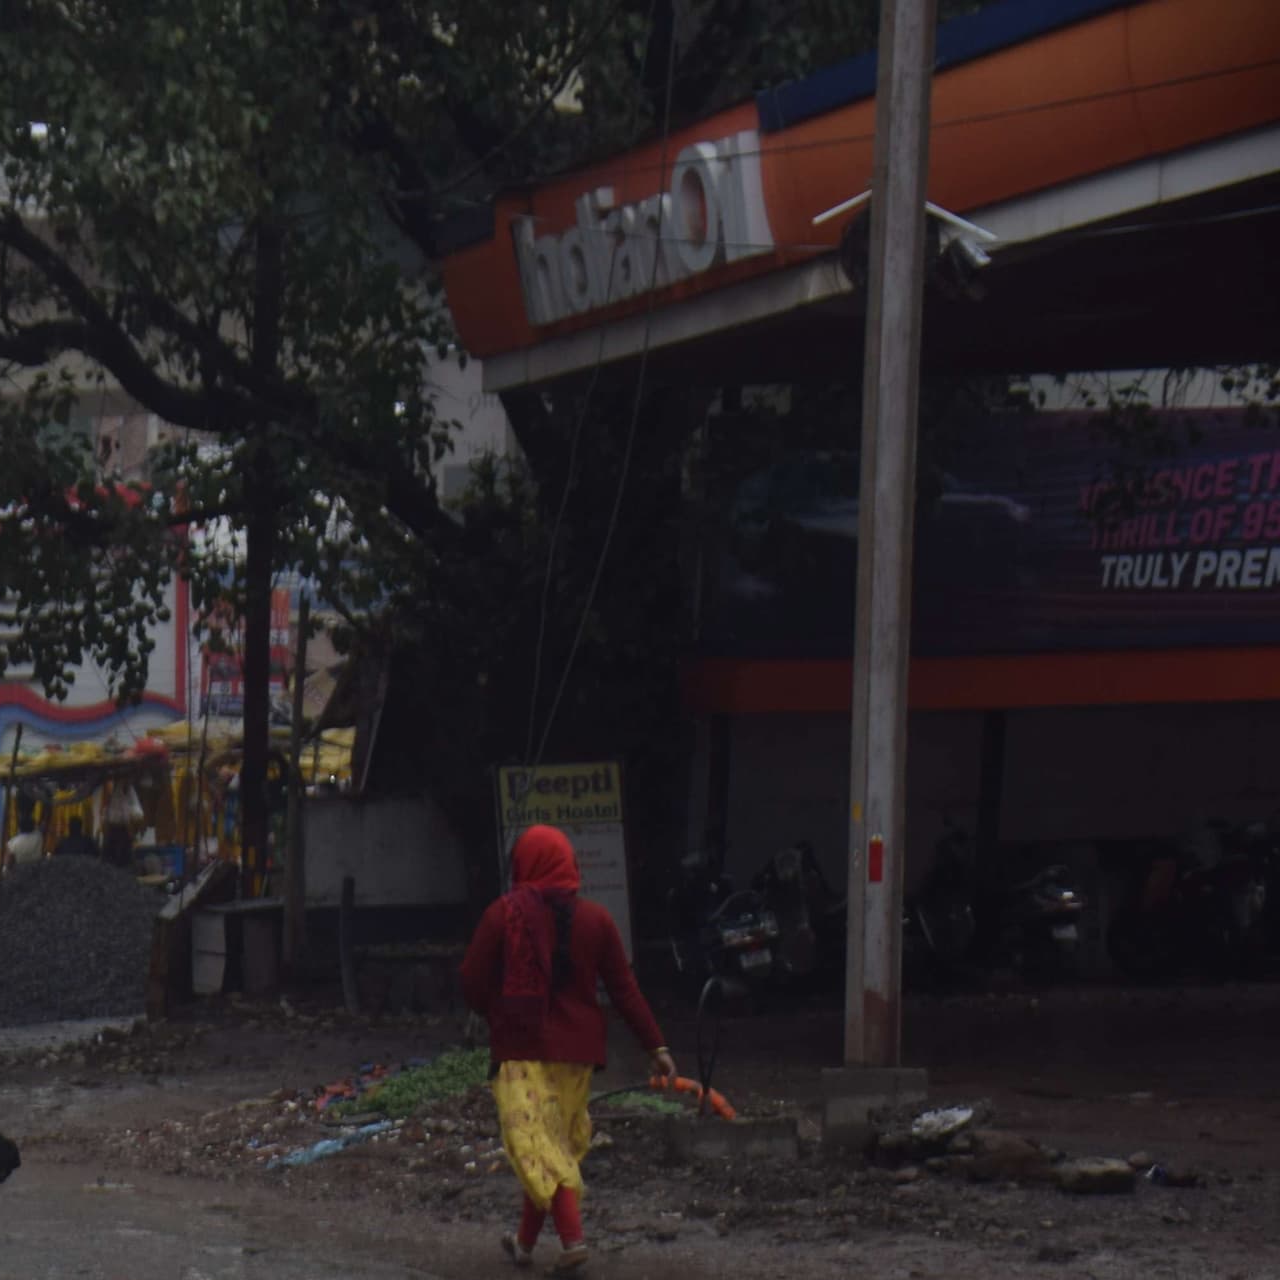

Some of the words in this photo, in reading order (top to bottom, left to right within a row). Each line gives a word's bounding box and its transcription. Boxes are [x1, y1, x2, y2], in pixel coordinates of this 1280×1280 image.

[510, 130, 776, 326] IndianOil
[1189, 505, 1237, 545] OF
[1100, 552, 1191, 589] TRULY
